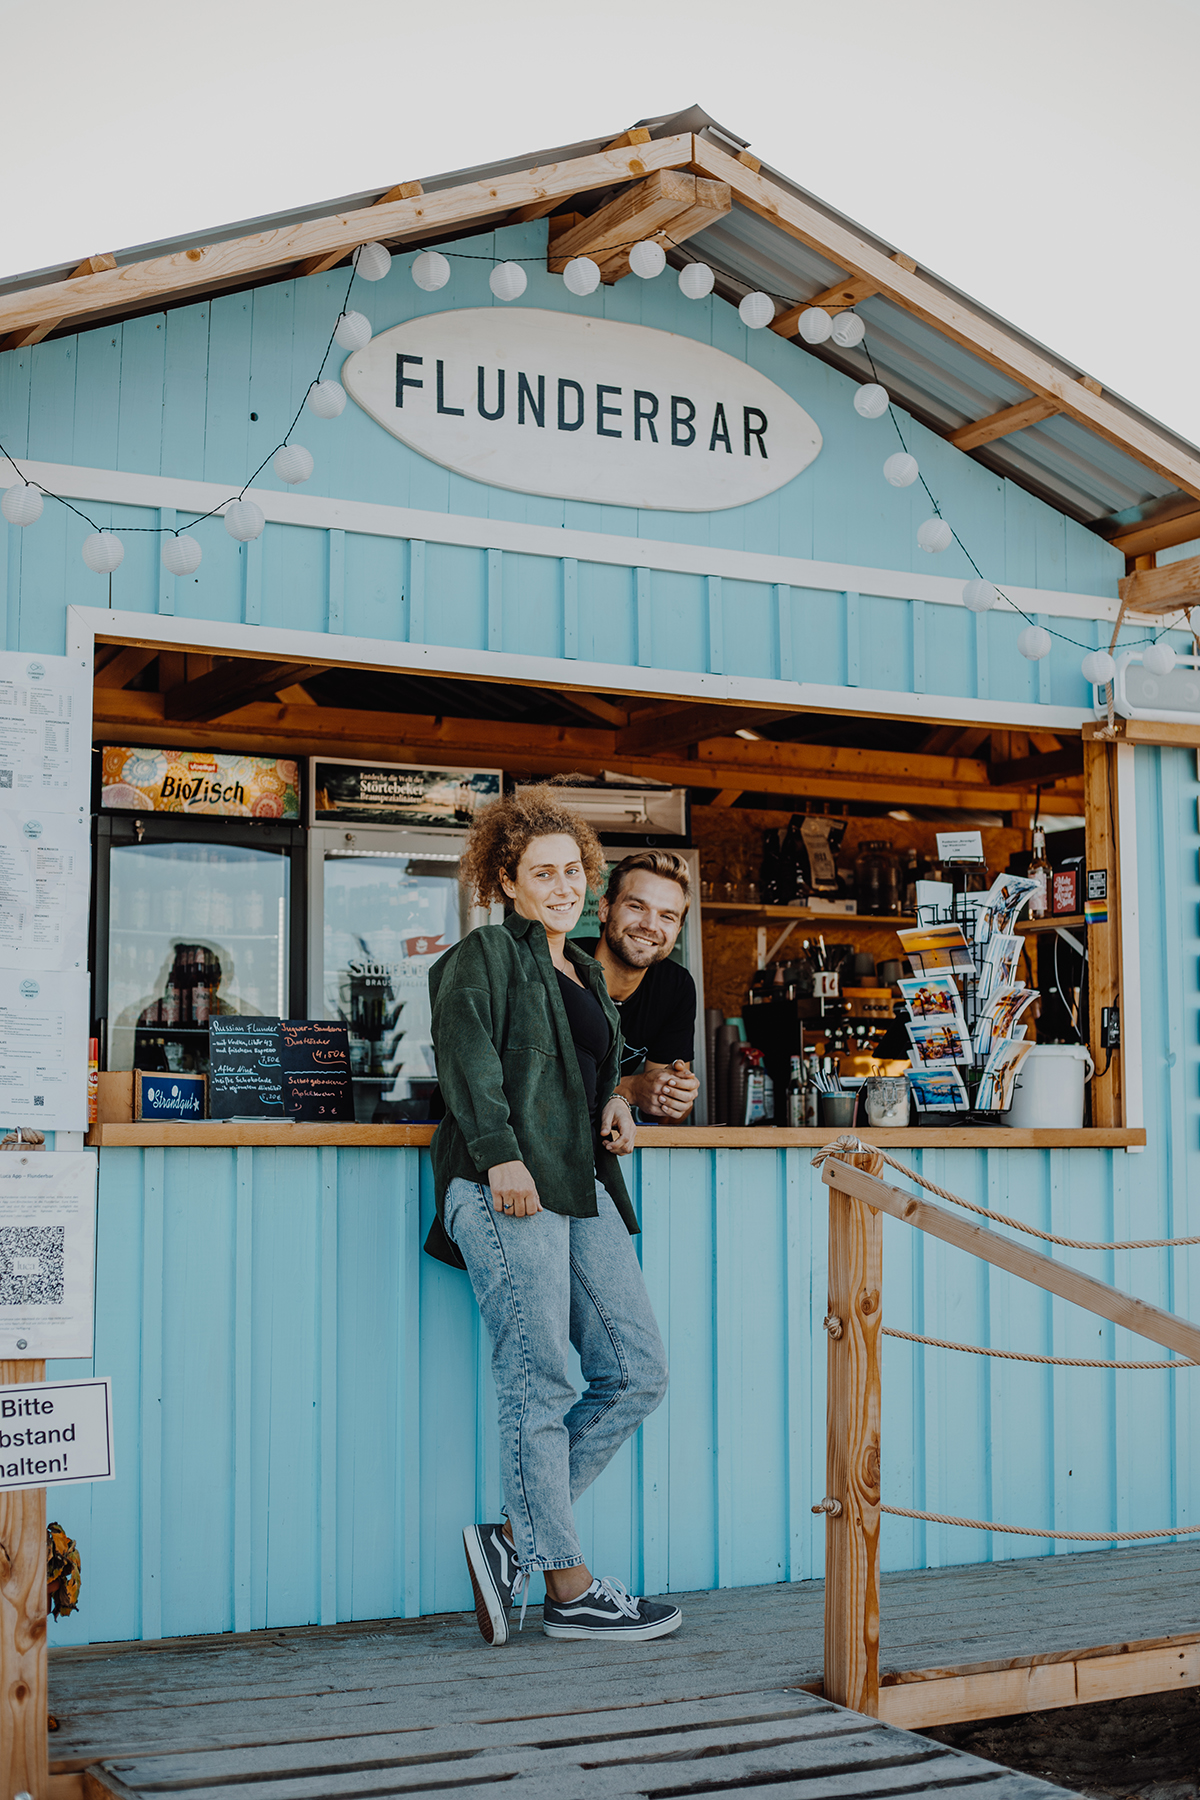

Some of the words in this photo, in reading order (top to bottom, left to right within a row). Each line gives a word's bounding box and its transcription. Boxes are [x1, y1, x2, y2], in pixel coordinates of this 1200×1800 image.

[395, 353, 769, 459] FLUNDERBAR
[160, 776, 244, 806] BioZisch
[360, 780, 424, 796] Störtebeker
[152, 1089, 194, 1117] Strandgut
[318, 1105, 326, 1114] 3
[17, 1260, 36, 1271] luca
[1, 1397, 54, 1418] Bitte
